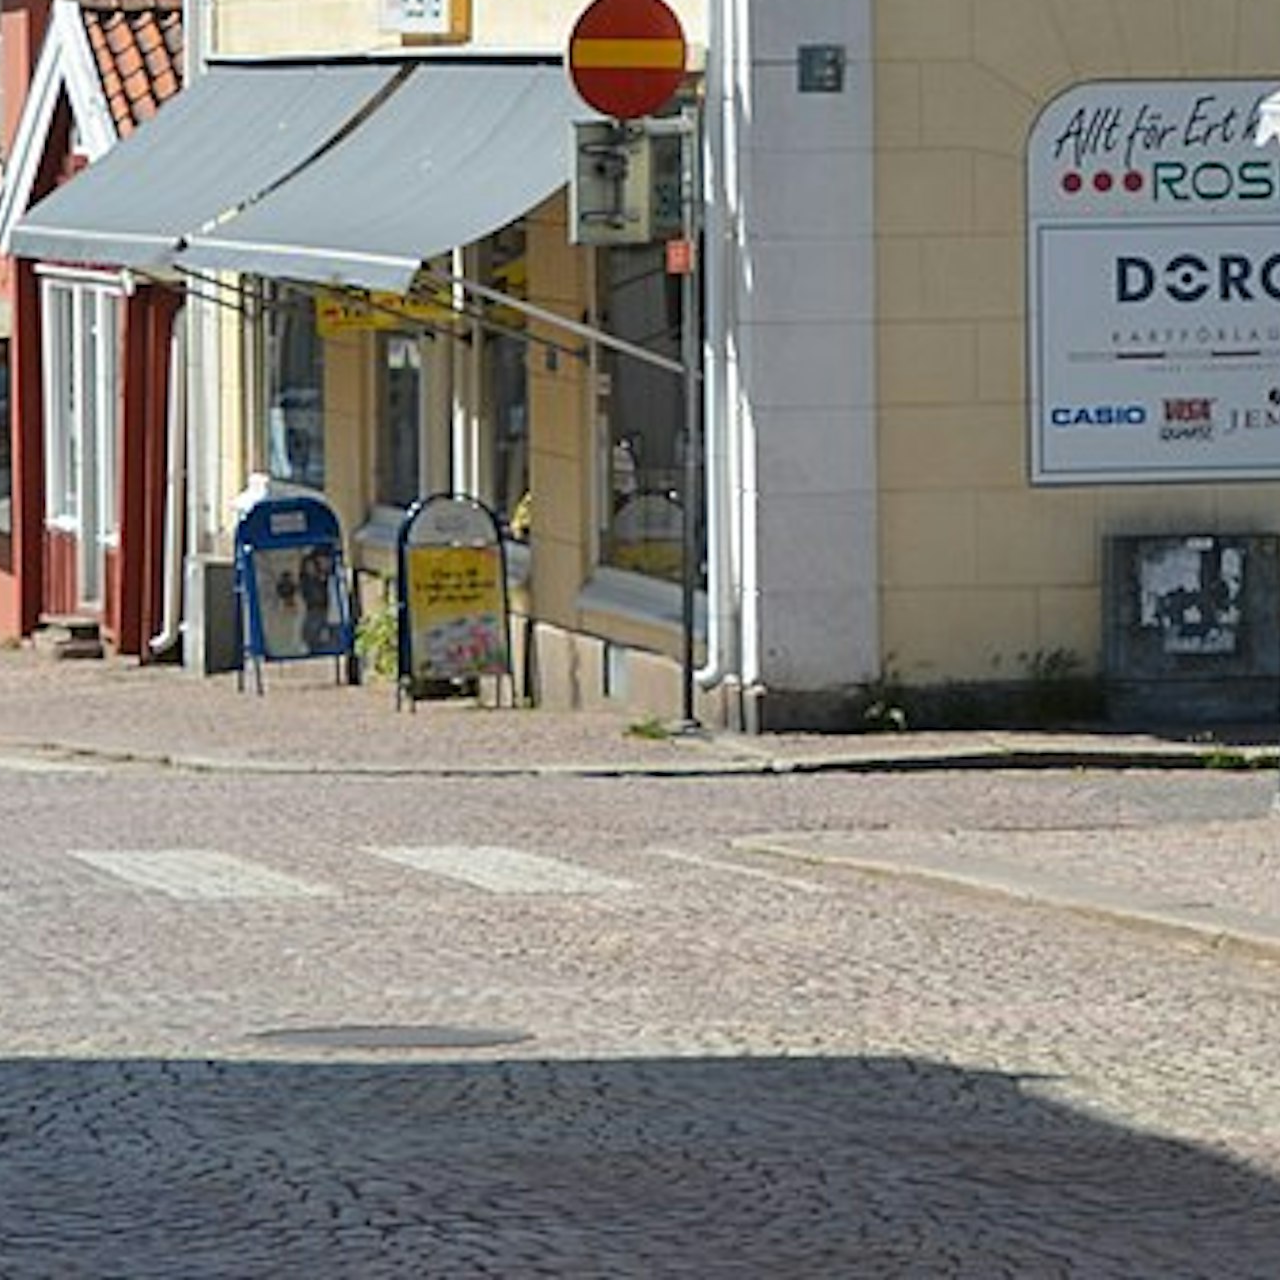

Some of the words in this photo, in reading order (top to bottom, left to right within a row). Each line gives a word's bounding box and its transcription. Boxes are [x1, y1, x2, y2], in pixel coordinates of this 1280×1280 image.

[1054, 106, 1120, 166] Allt
[1125, 104, 1177, 169] för
[1184, 96, 1236, 146] Ert
[1051, 406, 1147, 426] CASIO
